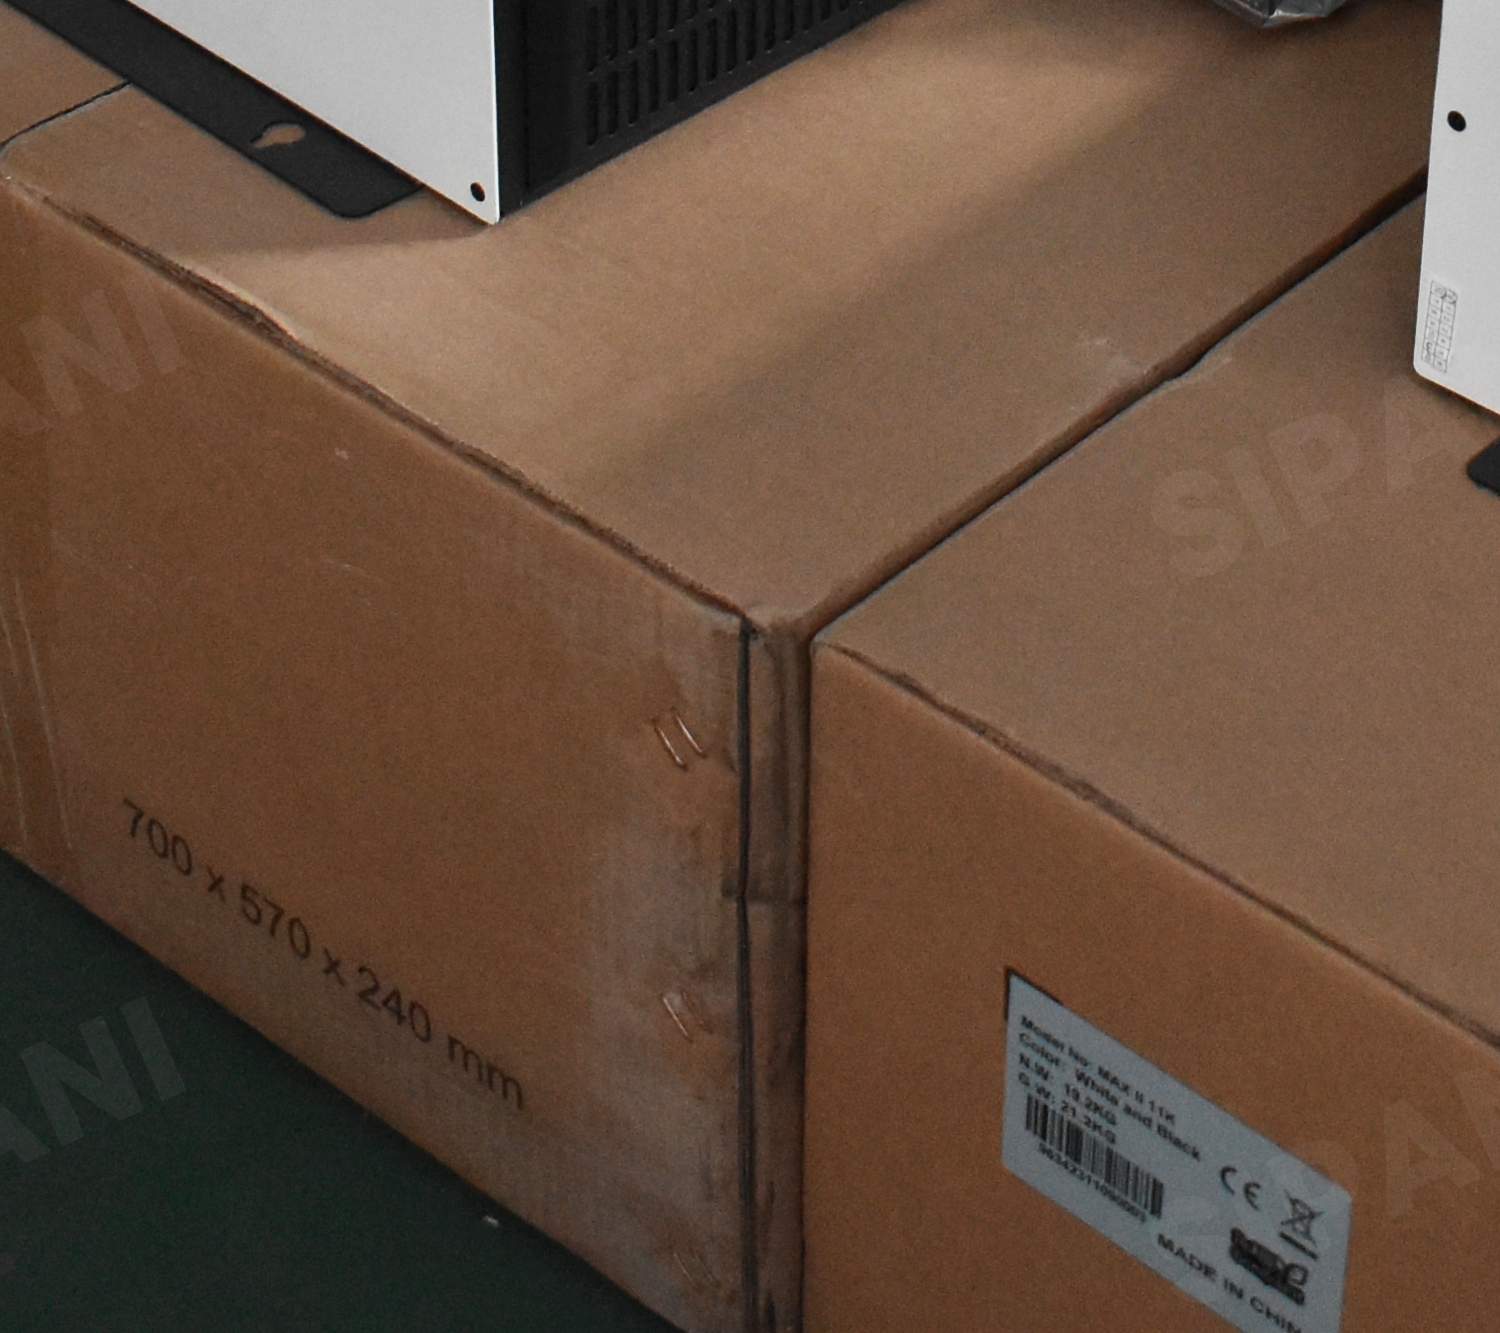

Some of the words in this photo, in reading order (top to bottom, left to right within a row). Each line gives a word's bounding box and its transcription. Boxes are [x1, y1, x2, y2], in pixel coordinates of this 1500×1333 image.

[123, 797, 193, 876] 700
[206, 865, 227, 903] x
[240, 883, 311, 960] 570
[322, 947, 346, 987] x
[358, 965, 432, 1043] 240
[447, 1034, 526, 1111] mm
[1074, 1068, 1120, 1107] White
[1123, 1102, 1153, 1130] and
[1156, 1123, 1202, 1163] Black
[1097, 1064, 1131, 1095] MAX
[1147, 1099, 1178, 1126] 11K
[1156, 1232, 1218, 1284] MADE
[1223, 1276, 1246, 1301] IN
